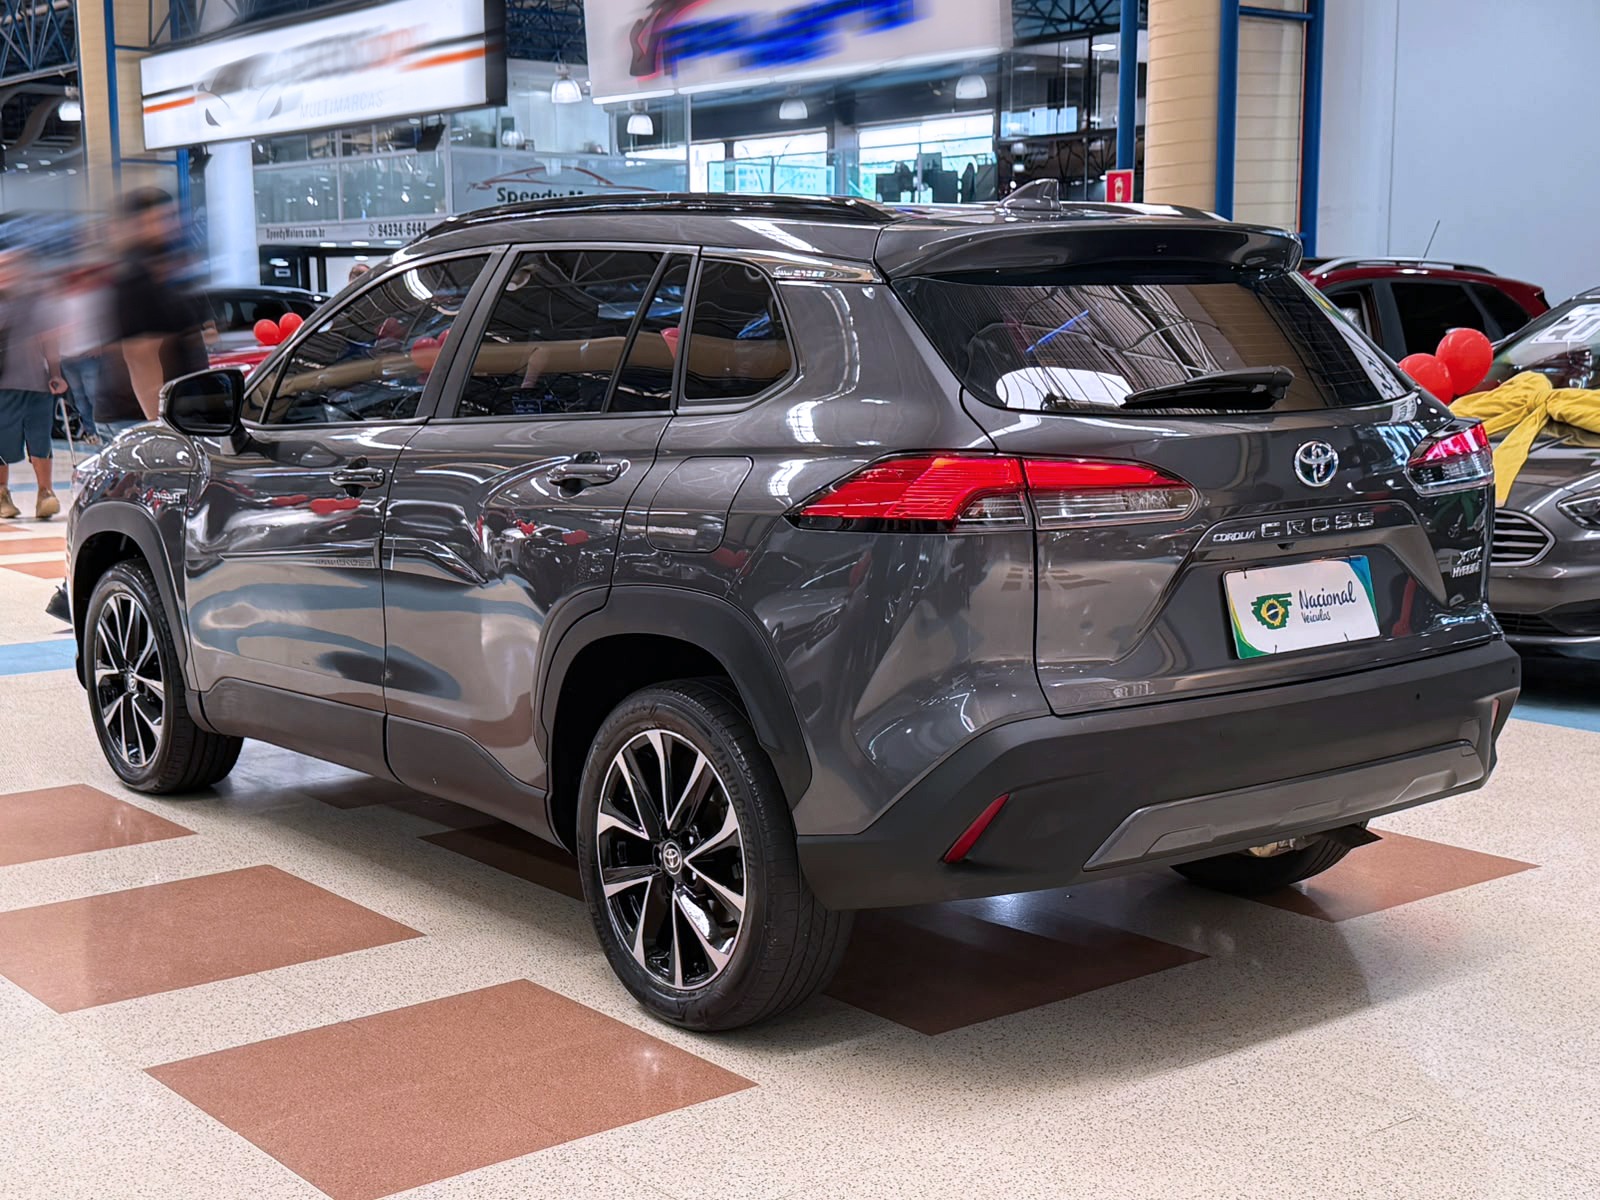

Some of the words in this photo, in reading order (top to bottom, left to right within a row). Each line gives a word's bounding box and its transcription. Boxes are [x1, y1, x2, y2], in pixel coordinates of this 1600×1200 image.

[299, 89, 384, 118] MULTIMARCAS
[497, 187, 563, 203] Speed
[1212, 530, 1256, 542] COROLLA
[1261, 512, 1374, 538] CROSS
[1457, 546, 1482, 565] XRX
[1298, 580, 1357, 610] Nacional
